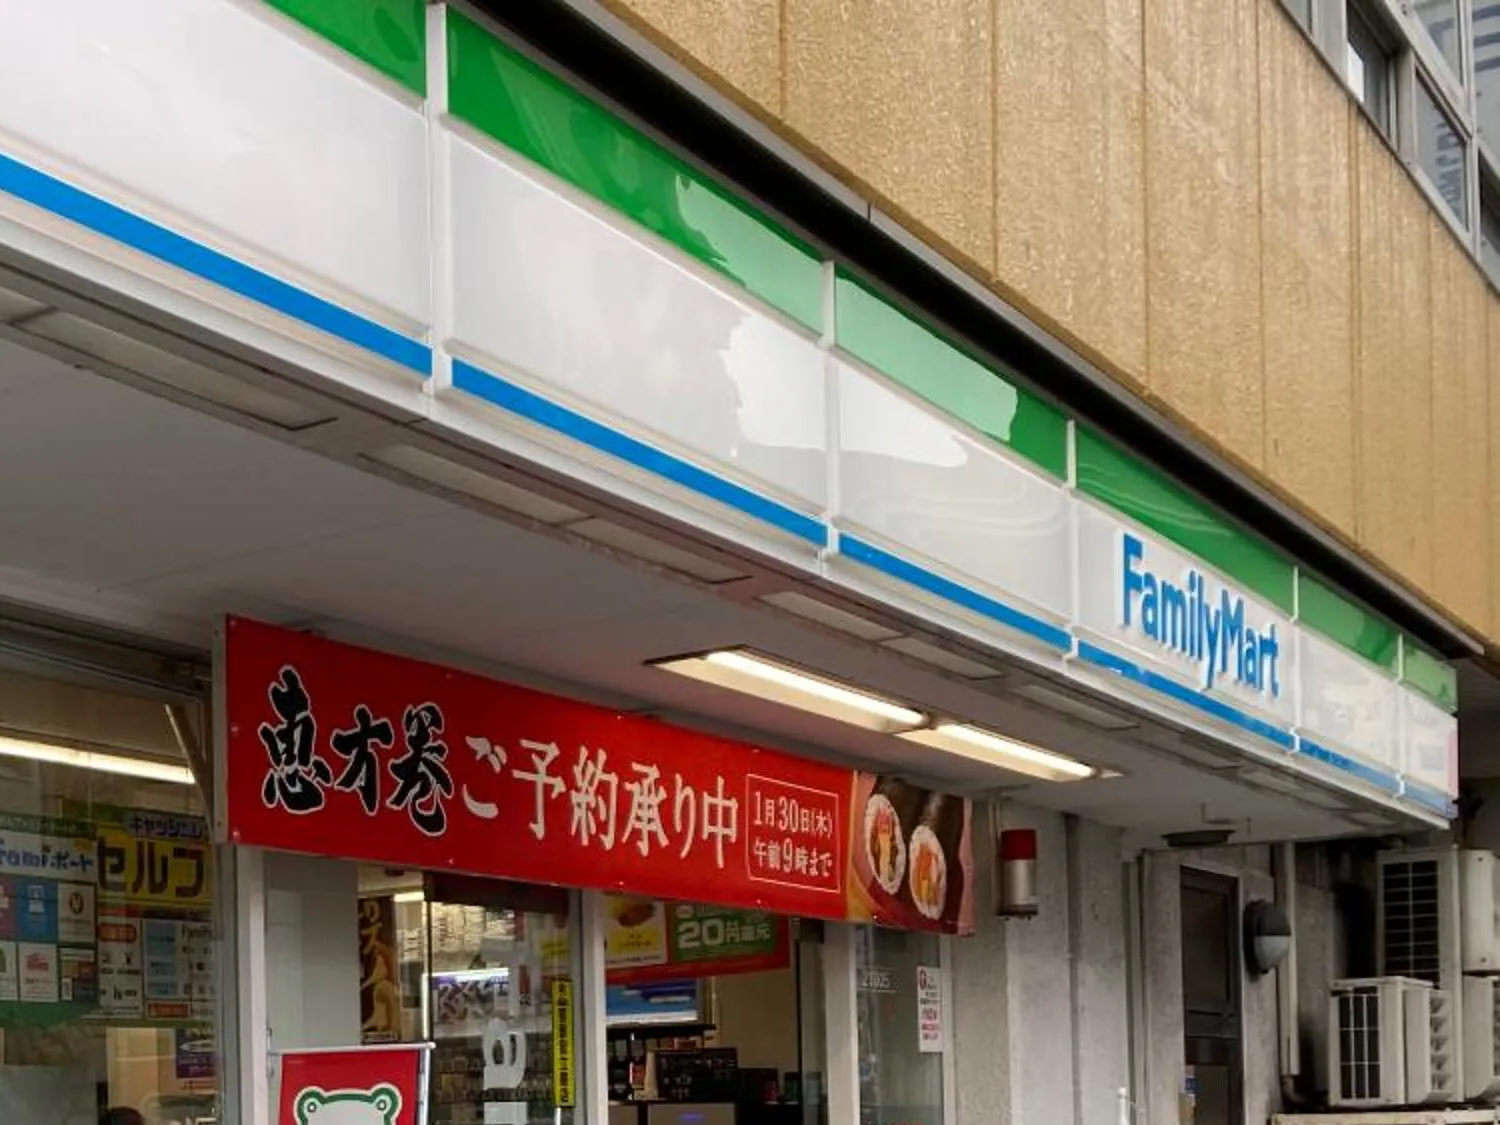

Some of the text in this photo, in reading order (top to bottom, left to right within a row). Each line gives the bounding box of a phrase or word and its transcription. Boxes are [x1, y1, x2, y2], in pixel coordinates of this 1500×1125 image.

[1122, 531, 1279, 698] FamilyMart
[257, 664, 740, 870] 恵方巻 ご予約承り中
[754, 790, 834, 840] 1月30日(木)
